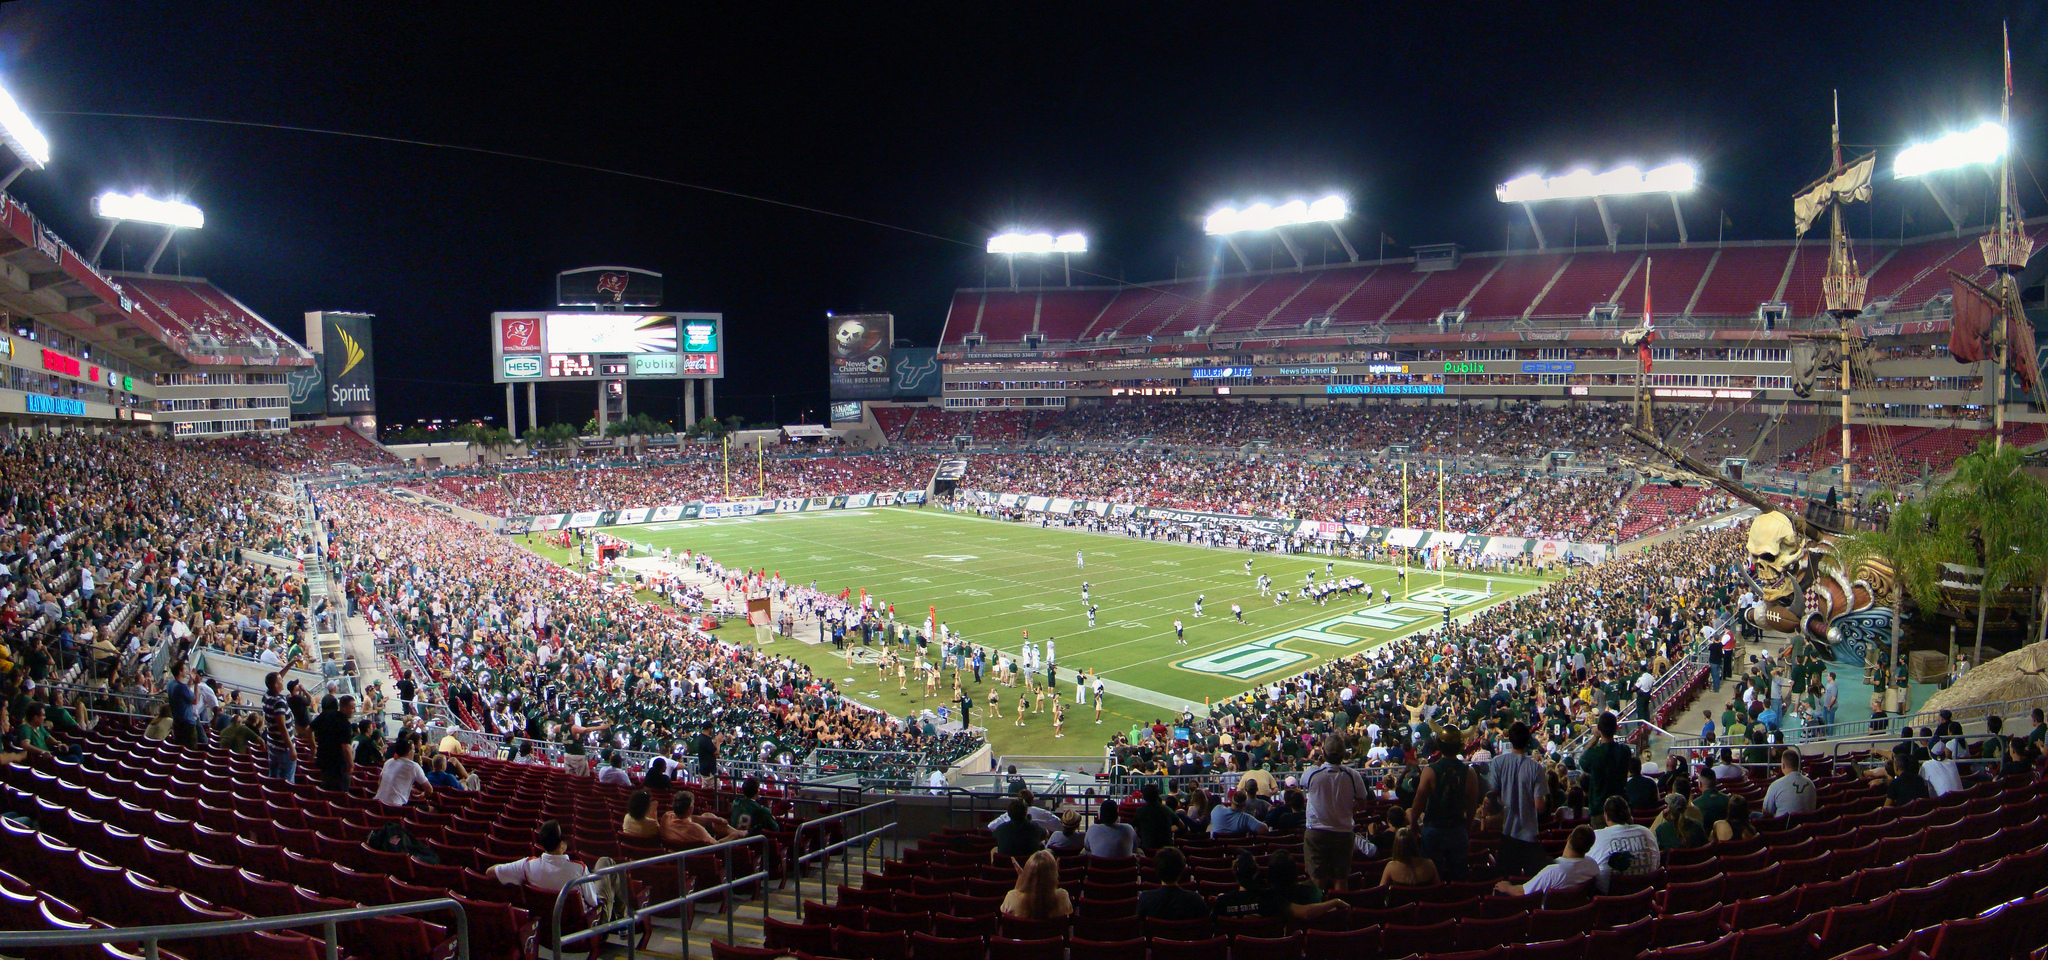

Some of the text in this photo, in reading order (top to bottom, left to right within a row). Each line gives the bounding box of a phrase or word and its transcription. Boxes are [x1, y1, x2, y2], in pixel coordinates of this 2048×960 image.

[508, 362, 537, 371] HESS
[636, 359, 675, 369] Publix
[868, 355, 883, 373] 8
[1369, 364, 1402, 375] bright house
[1444, 362, 1485, 373] Publix
[1522, 361, 1575, 373] GEICO
[1193, 367, 1252, 378] MILLER LITE
[1300, 366, 1330, 375] Channel
[332, 384, 371, 406] Sprint
[1326, 385, 1445, 394] RAYMOND JAMES STADIUM
[28, 394, 54, 413] RAYMOND
[1167, 512, 1194, 522] EAST
[1176, 586, 1506, 680] BULLS
[1553, 724, 1561, 736] 8
[1610, 835, 1649, 853] COME
